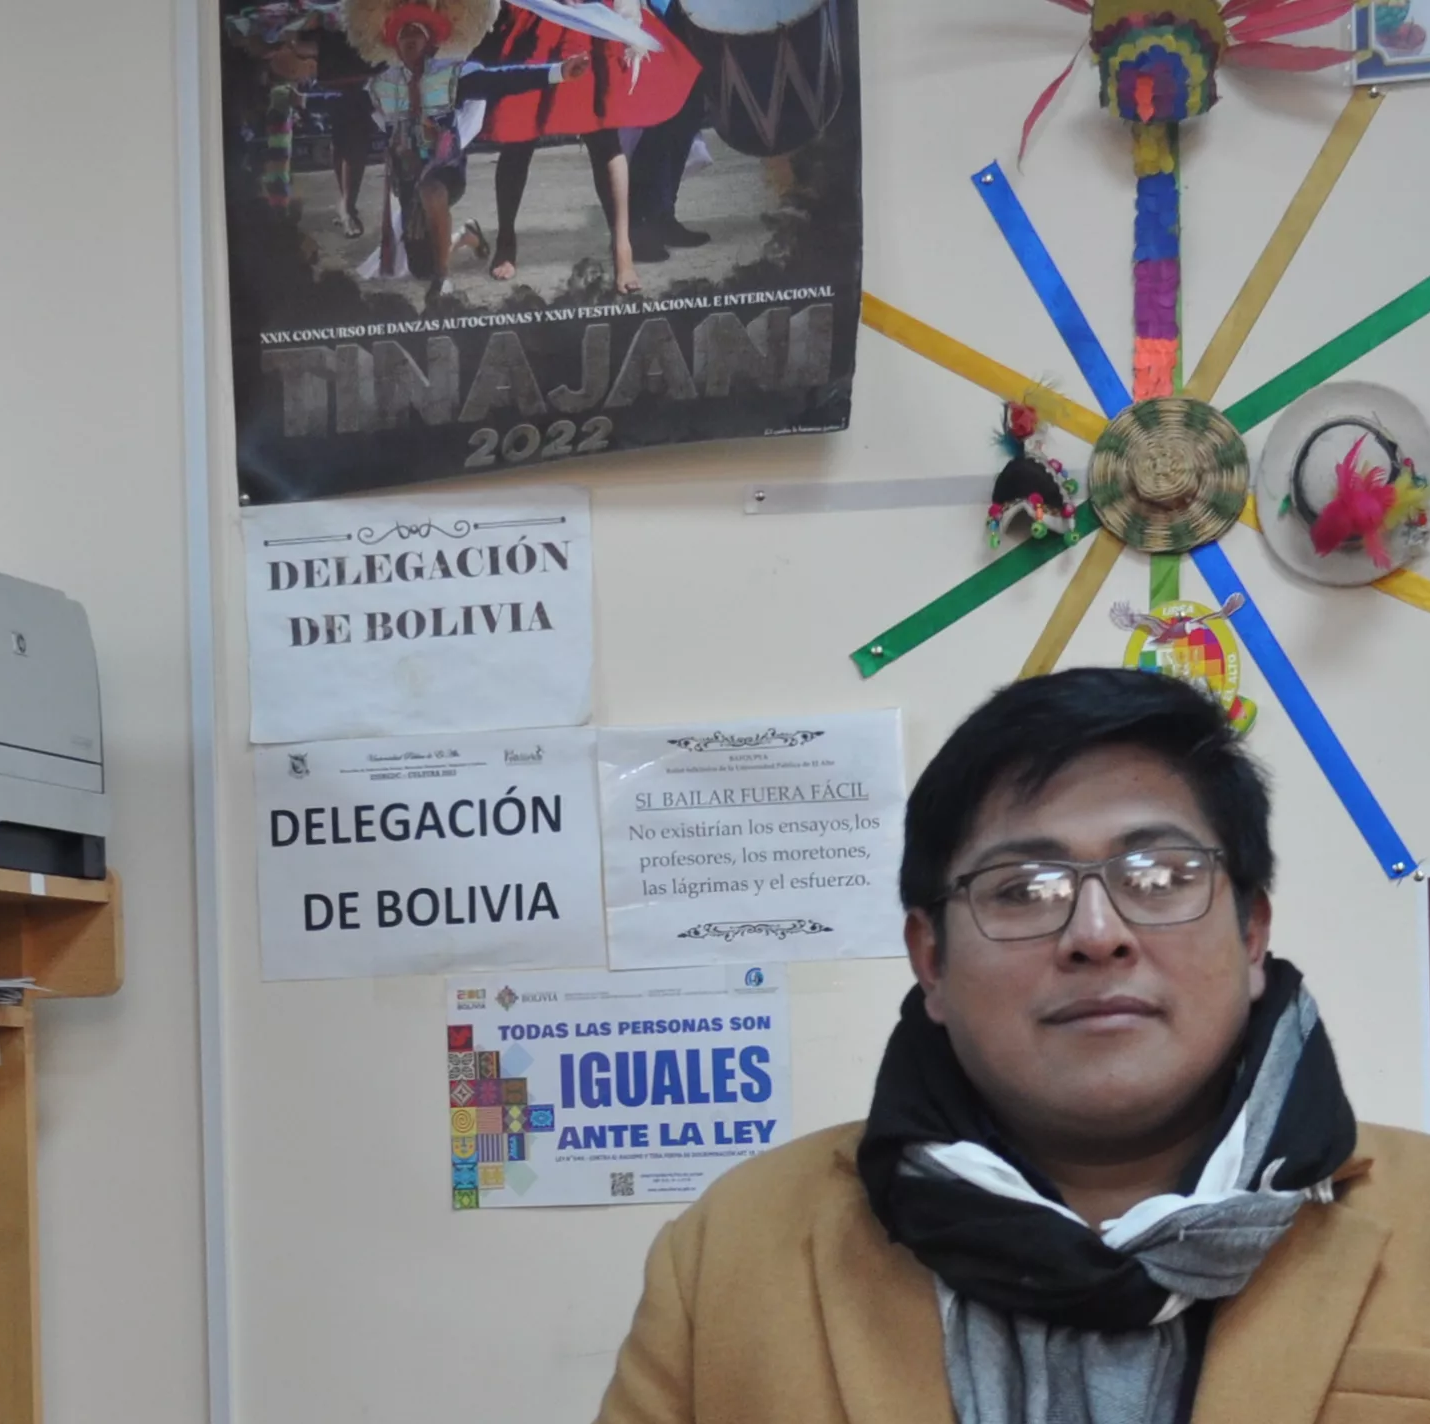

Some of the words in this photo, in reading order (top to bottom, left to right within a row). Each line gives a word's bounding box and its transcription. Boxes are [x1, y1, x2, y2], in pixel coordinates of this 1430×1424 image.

[260, 331, 291, 344] XXIX
[293, 324, 365, 341] CONCURSO
[368, 322, 385, 336] DE
[387, 320, 439, 334] DANZAS
[442, 312, 532, 330] AUTOCTONAS
[533, 310, 543, 322] Y
[545, 306, 576, 322] XXIV
[578, 304, 640, 319] FESTIVAL
[642, 298, 711, 313] NACIONAL
[713, 296, 722, 306] E
[724, 286, 835, 305] INTERNACIONAL
[464, 416, 613, 468] 2022
[267, 536, 571, 591] DELEGACIÓN
[287, 614, 351, 647] DE
[364, 601, 554, 642] BOLIVIA
[271, 786, 561, 847] DELEGACIÓN
[635, 792, 652, 809] SI
[663, 789, 735, 807] BAILAR
[741, 785, 805, 803] FUERA
[811, 779, 869, 800] FÁCIL
[629, 824, 656, 842] No
[661, 821, 742, 840] existirían
[748, 819, 774, 835] los
[640, 849, 736, 873] profesores,
[742, 847, 767, 863] los
[773, 845, 870, 862] moretones,
[304, 892, 360, 931] DE
[377, 881, 560, 928] BOLIVIA
[642, 880, 666, 896] las
[672, 877, 749, 899] lágrimas
[754, 879, 764, 896] y
[770, 875, 784, 889] el
[790, 871, 870, 889] esfuerzo.
[498, 1023, 569, 1041] TODAS
[576, 1022, 611, 1037] LAS
[618, 1017, 723, 1035] PERSONAS
[730, 1016, 771, 1031] SON
[560, 1045, 772, 1109] IGUALES
[557, 1124, 649, 1150] ANTE
[660, 1122, 704, 1147] LA
[714, 1120, 777, 1145] LEY
